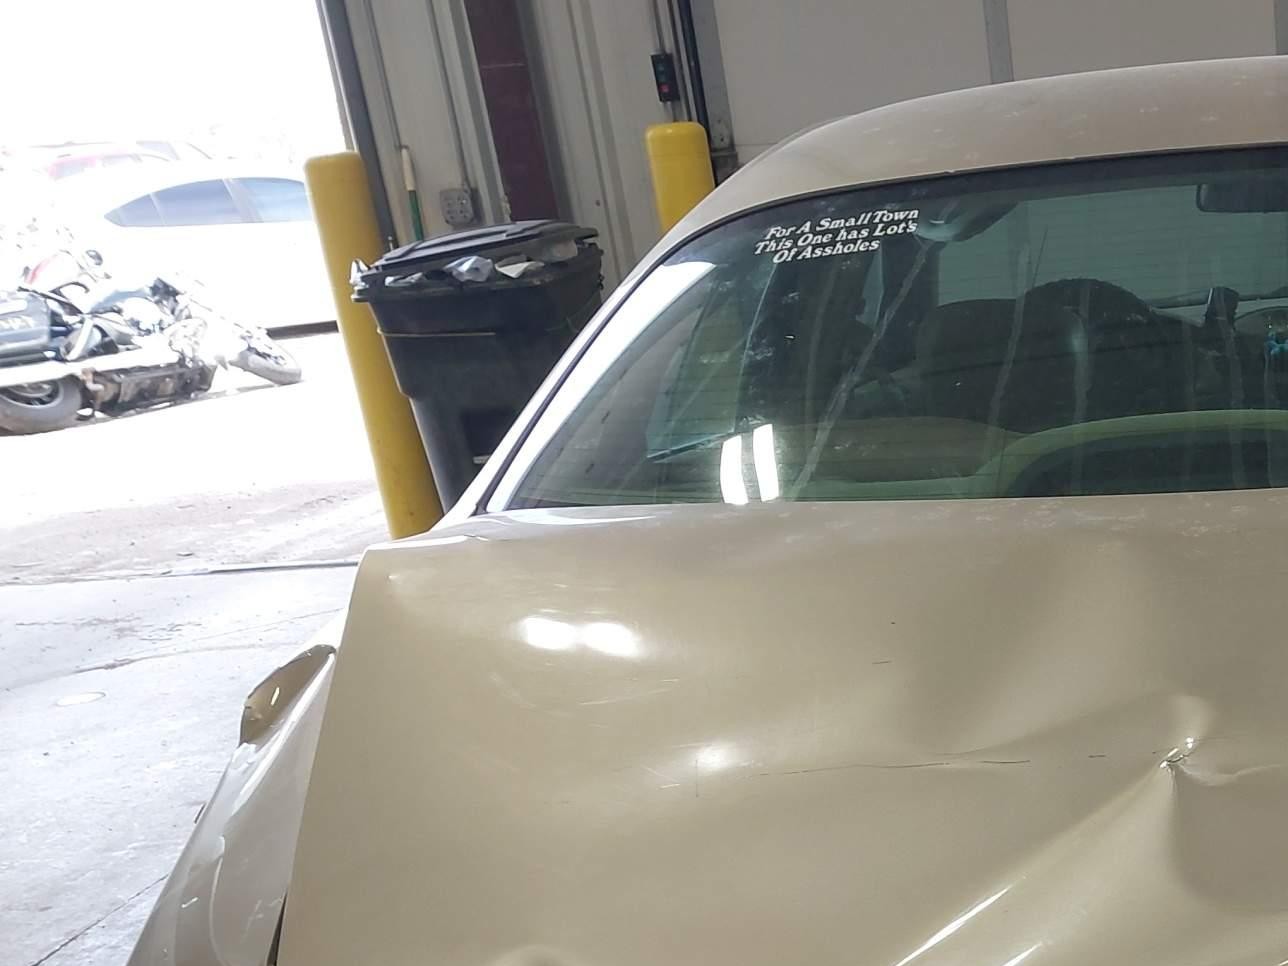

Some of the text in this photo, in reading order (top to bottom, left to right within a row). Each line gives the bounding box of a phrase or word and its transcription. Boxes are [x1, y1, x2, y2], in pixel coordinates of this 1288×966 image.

[754, 221, 918, 255] This One has Lot's
[765, 209, 919, 240] For A Small Town
[773, 239, 880, 263] Of Assholes
